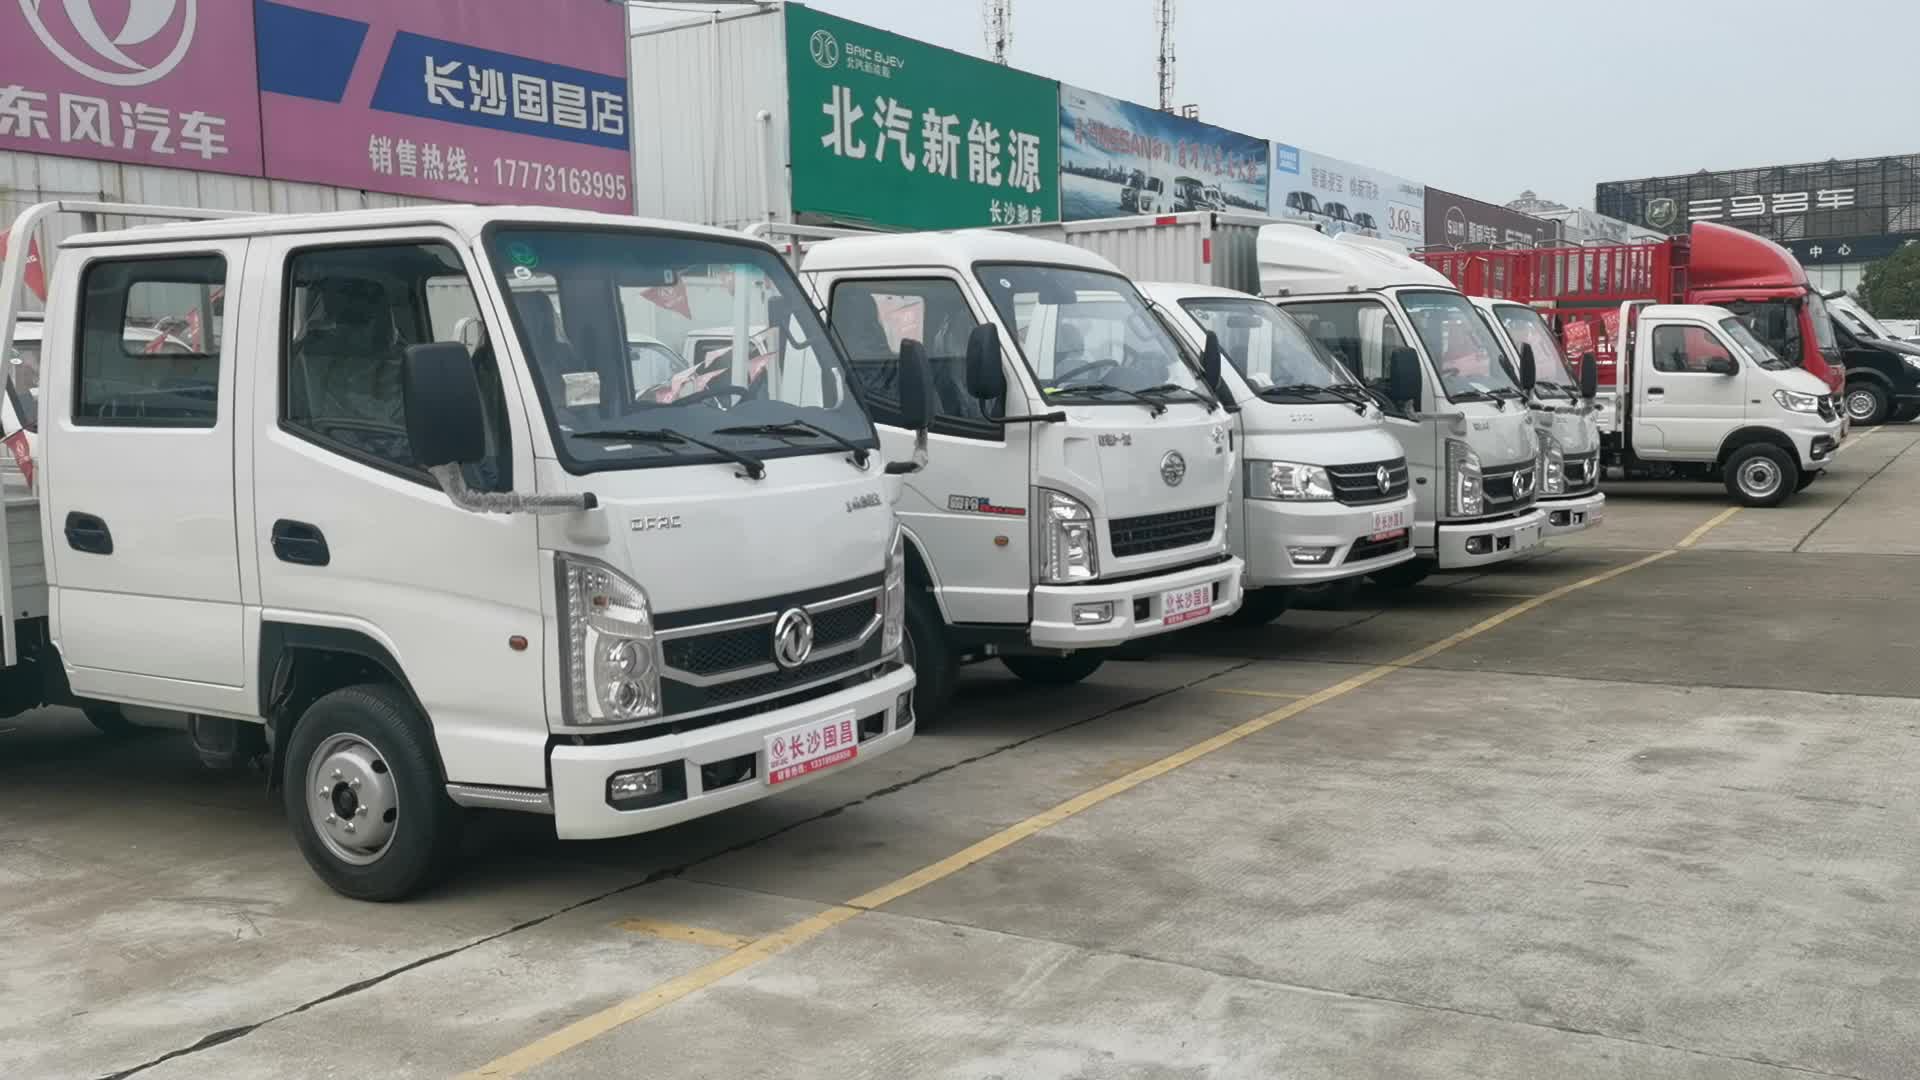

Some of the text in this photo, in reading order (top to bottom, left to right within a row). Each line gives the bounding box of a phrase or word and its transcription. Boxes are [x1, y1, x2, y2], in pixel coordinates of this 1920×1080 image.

[874, 51, 905, 69] BJEV
[424, 56, 624, 135] 长沙国昌店
[0, 84, 229, 159] 东风汽车
[821, 85, 1041, 193] 北汽新能源
[493, 157, 627, 201] 17773163995
[1388, 206, 1410, 234] 3.68
[631, 514, 682, 532] DFAC
[789, 719, 852, 760] 长沙国昌
